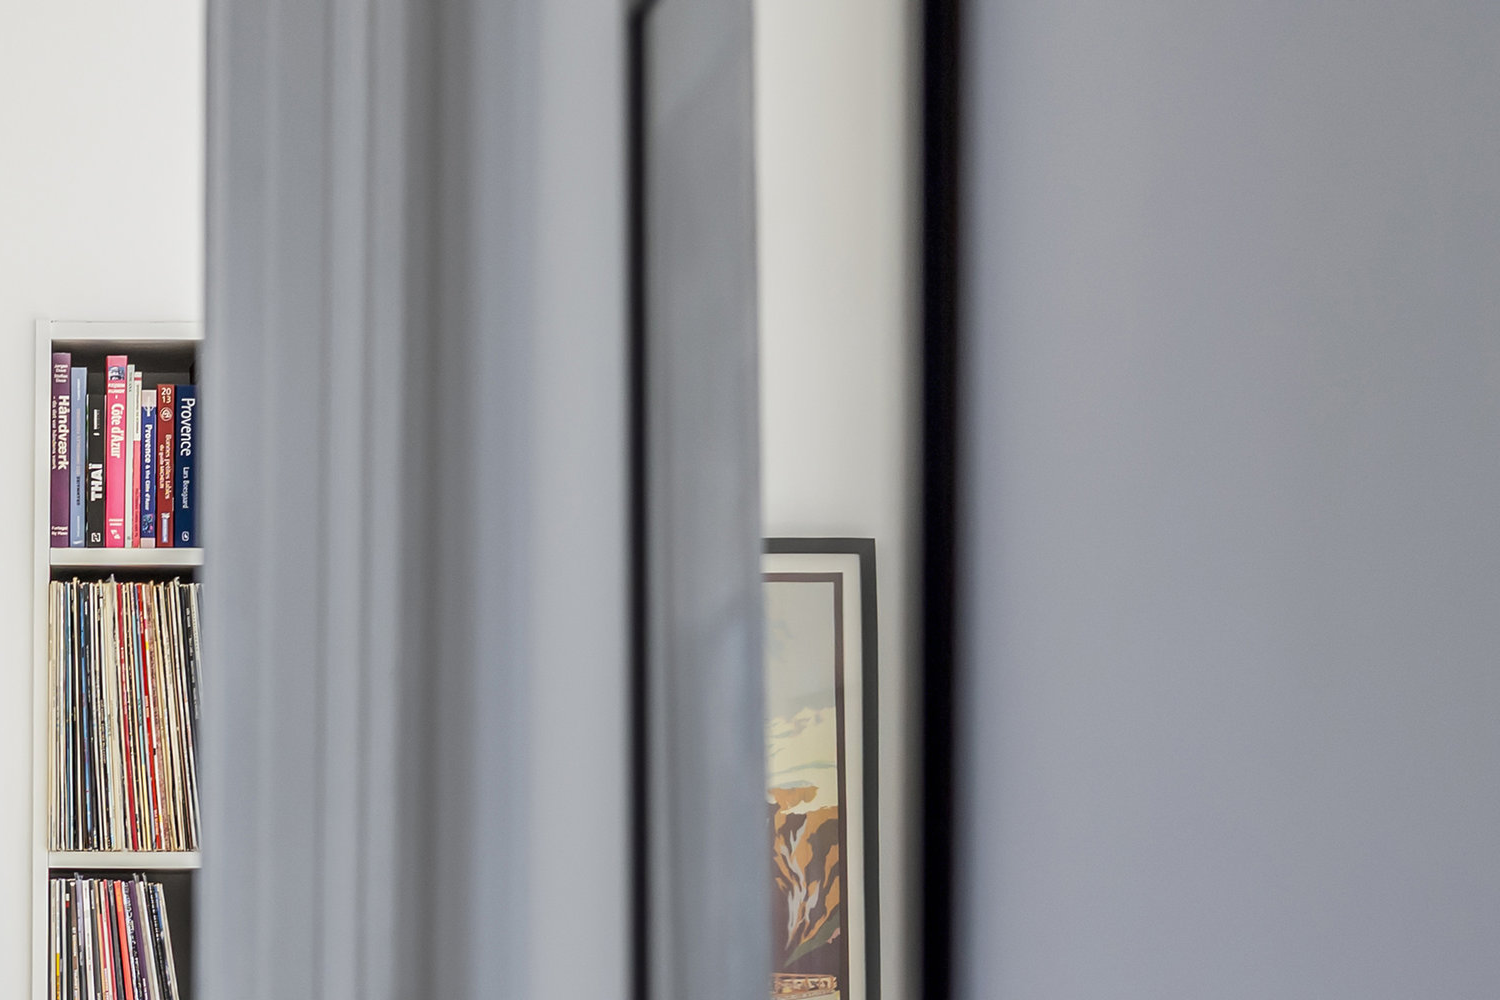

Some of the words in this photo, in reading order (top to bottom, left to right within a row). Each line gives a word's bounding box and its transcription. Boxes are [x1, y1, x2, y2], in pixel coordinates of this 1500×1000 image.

[162, 387, 171, 396] 20
[111, 403, 124, 425] Côte
[180, 398, 195, 456] Provence
[57, 395, 69, 470] Håndværk
[111, 427, 124, 458] d'Azur
[145, 424, 153, 463] Provence
[89, 463, 103, 501] THAÏ
[164, 459, 172, 479] petites
[164, 481, 172, 499] tables
[181, 480, 189, 508] Boesgaard
